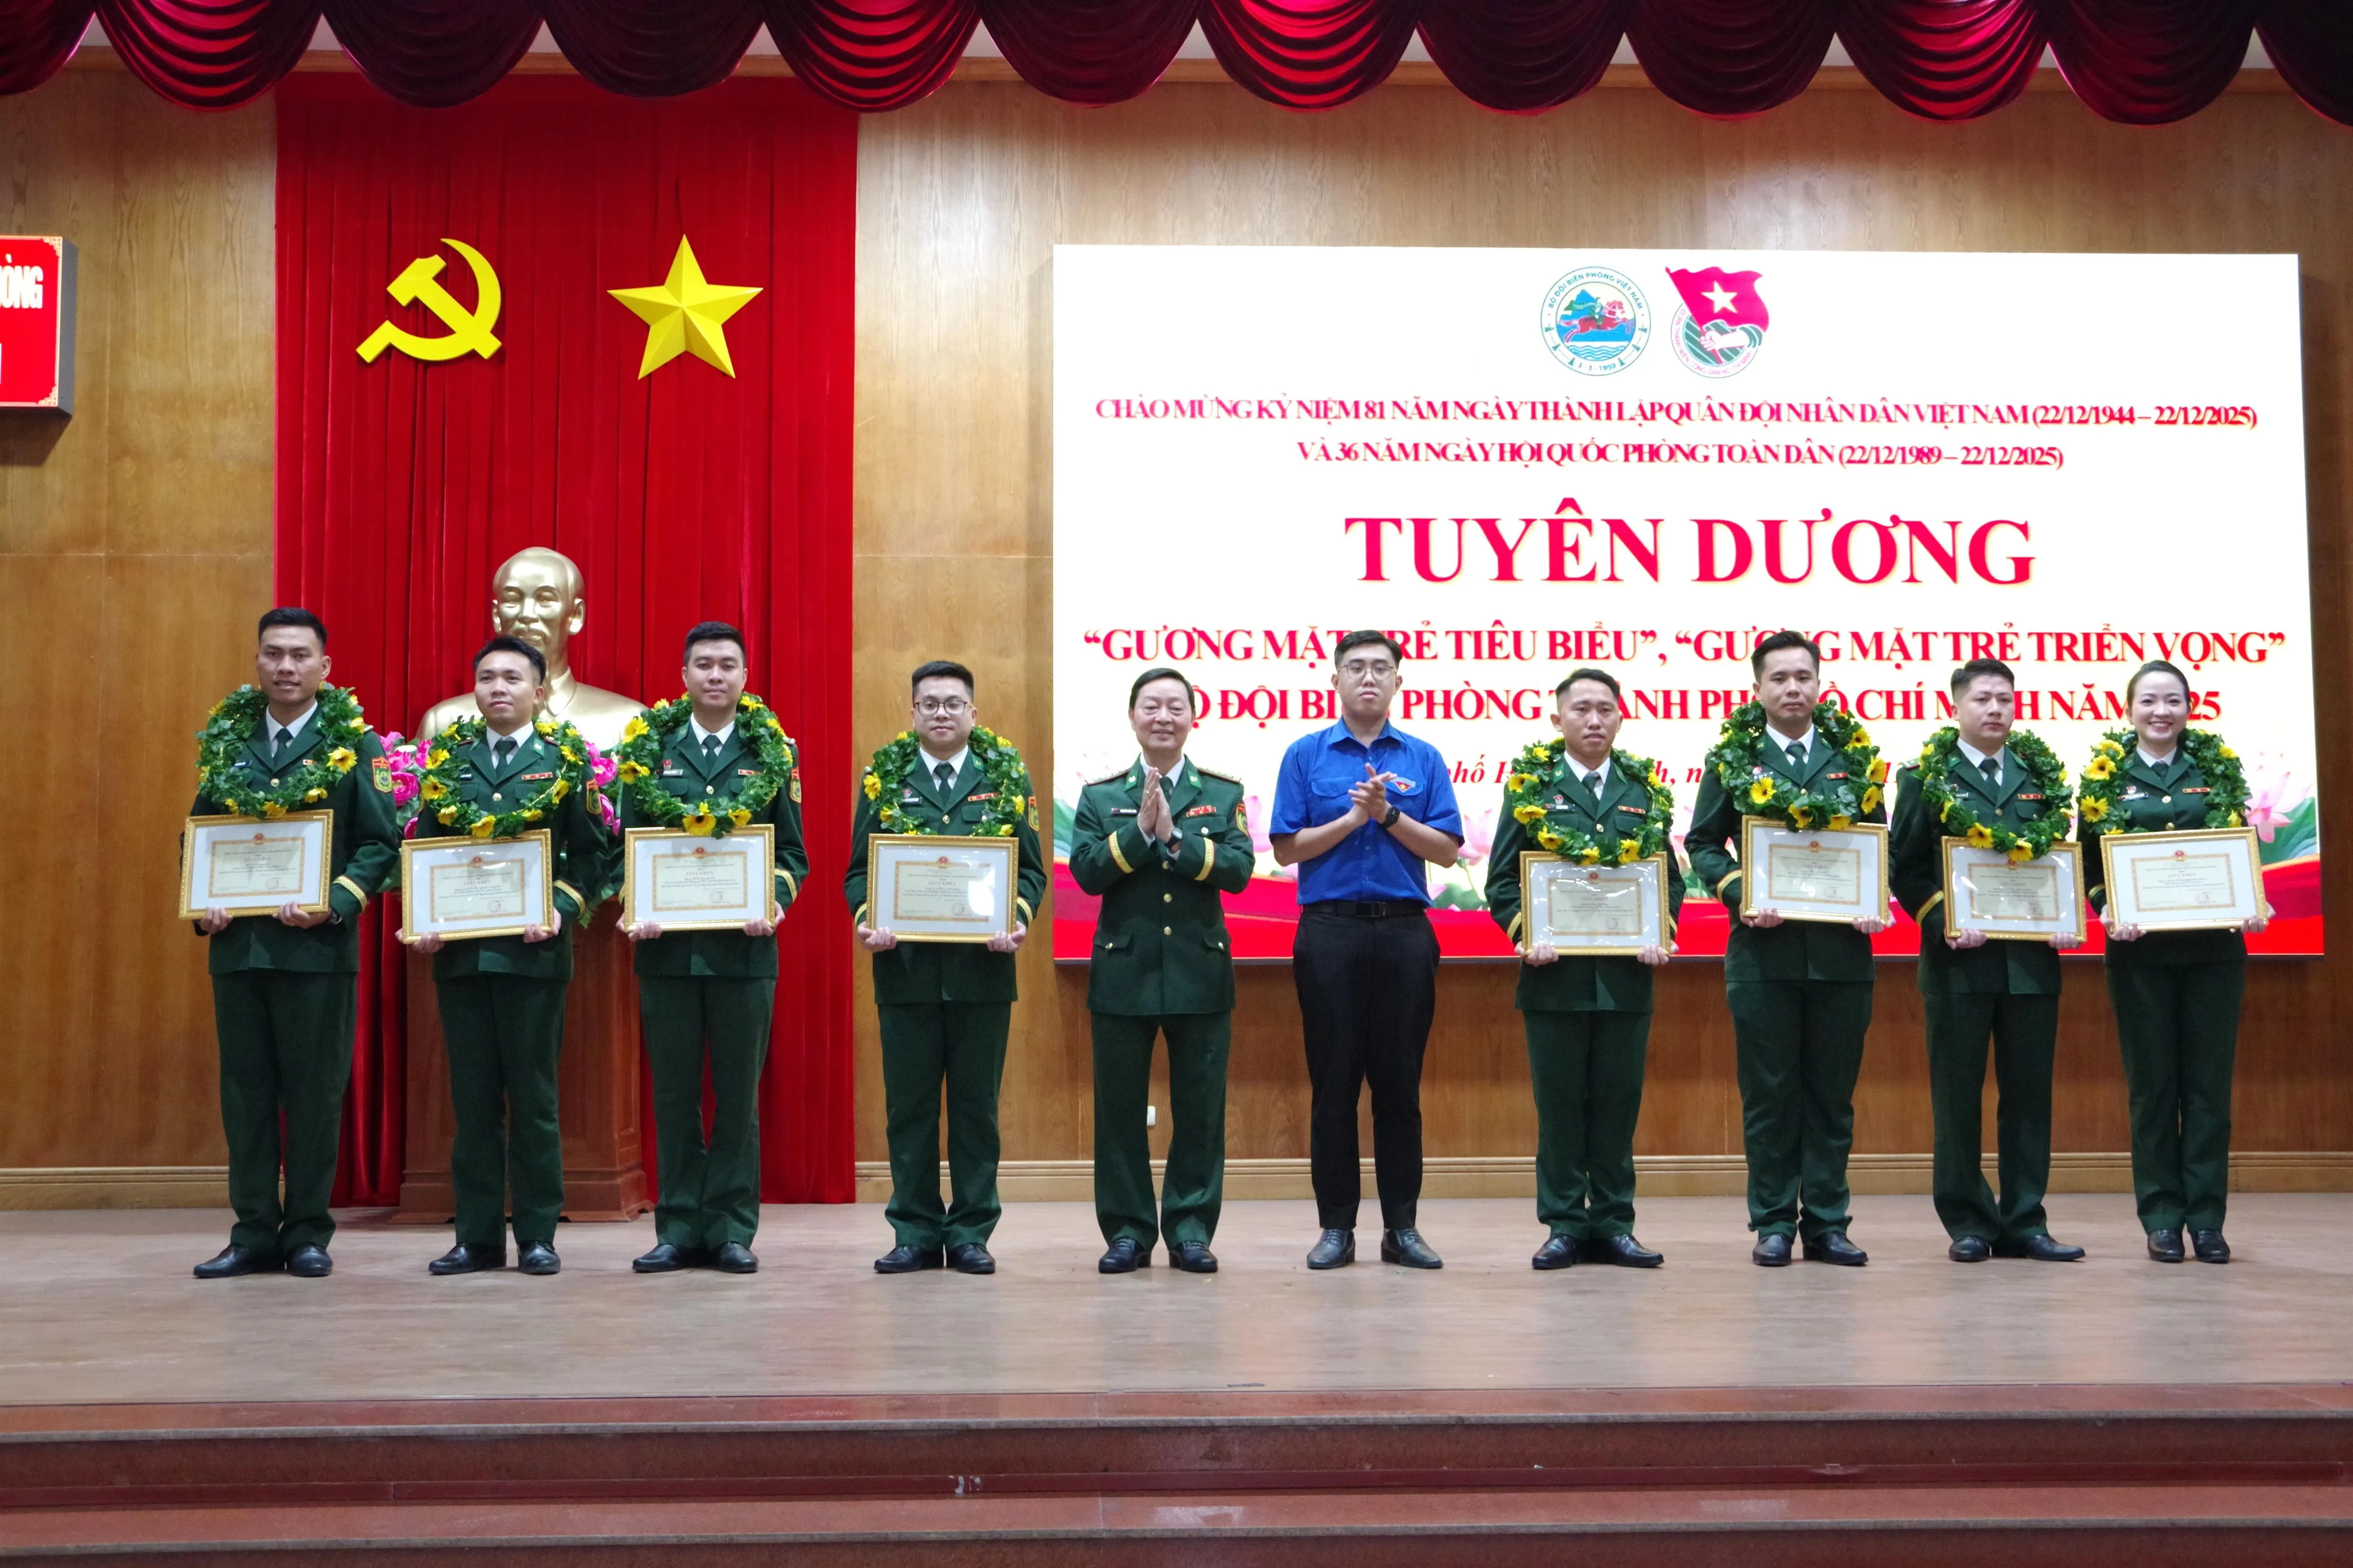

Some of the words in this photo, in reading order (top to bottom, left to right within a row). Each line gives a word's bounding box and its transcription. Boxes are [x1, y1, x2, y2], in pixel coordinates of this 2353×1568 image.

[1630, 291, 1643, 309] NAM
[1096, 394, 1170, 419] CHÀO
[1175, 394, 1252, 419] MỪNG
[1256, 393, 1291, 419] KỶ
[1297, 398, 1360, 425] NIỆM
[1364, 401, 1385, 420] 81
[1392, 397, 1449, 420] NĂM
[1453, 397, 1524, 420] NGÀY
[1524, 397, 1612, 421] THÀNH
[1617, 398, 1665, 427] LẬP
[1665, 396, 1734, 425] QUÂN
[1740, 398, 1782, 427] ĐỘI
[1787, 397, 1854, 423] NHÂN
[1860, 397, 1916, 423] DÂN
[1916, 399, 1969, 429] VIỆT
[1972, 405, 2028, 424] NAM
[2032, 405, 2136, 427] (22/12/1944
[2154, 406, 2257, 427] 22/12/2025)
[1298, 438, 1332, 461] VÀ
[1335, 442, 1359, 461] 36
[1363, 439, 1420, 461] NĂM
[1424, 439, 1495, 462] NGÀY
[1498, 441, 1543, 468] HỘI
[1547, 438, 1619, 467] QUỐC
[1623, 439, 1710, 463] PHÒNG
[1712, 439, 1779, 463] TOÀN
[1784, 438, 1834, 464] DÂN
[1838, 445, 1943, 467] (22/12/1989
[1960, 446, 2064, 469] 22/12/2025)
[1345, 498, 1664, 583] TUYÊN
[1690, 508, 2035, 585] DƯƠNG
[1446, 620, 1537, 660] TIÊU
[1849, 626, 1939, 671] MẶT
[1942, 622, 2021, 662] TRẺ
[2028, 622, 2145, 662] TRIỂN
[1218, 685, 1290, 728] ĐỘI
[1402, 680, 1542, 721] PHÒNG
[1855, 681, 1925, 721] CHÍ
